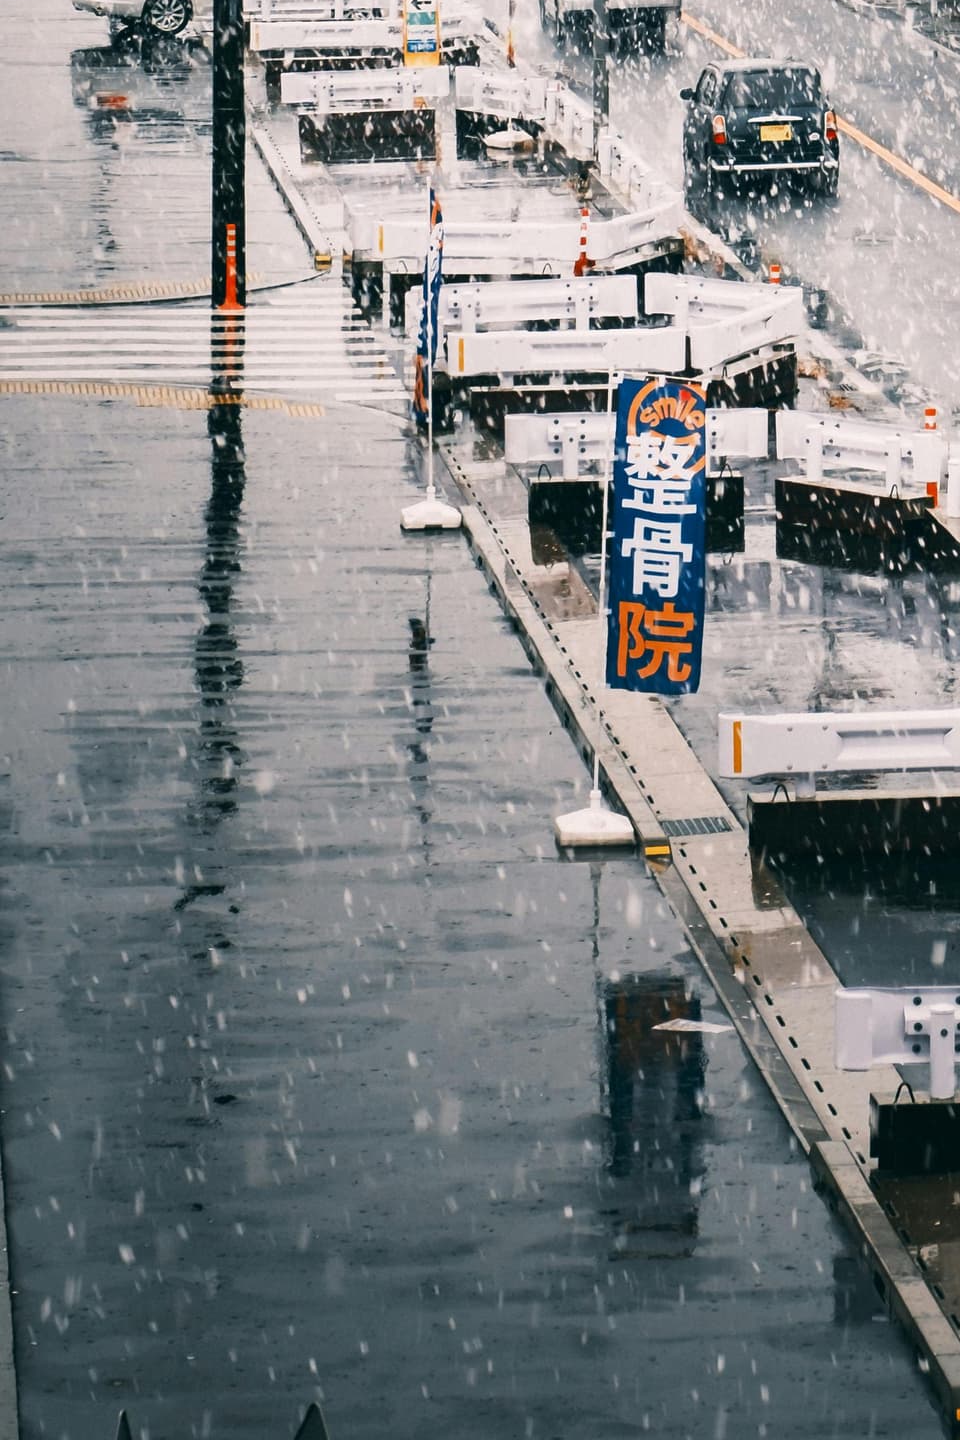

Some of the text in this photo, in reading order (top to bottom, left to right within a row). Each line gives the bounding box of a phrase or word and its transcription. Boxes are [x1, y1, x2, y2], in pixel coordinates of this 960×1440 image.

[640, 389, 705, 431] smile
[616, 431, 702, 683] 整骨院
